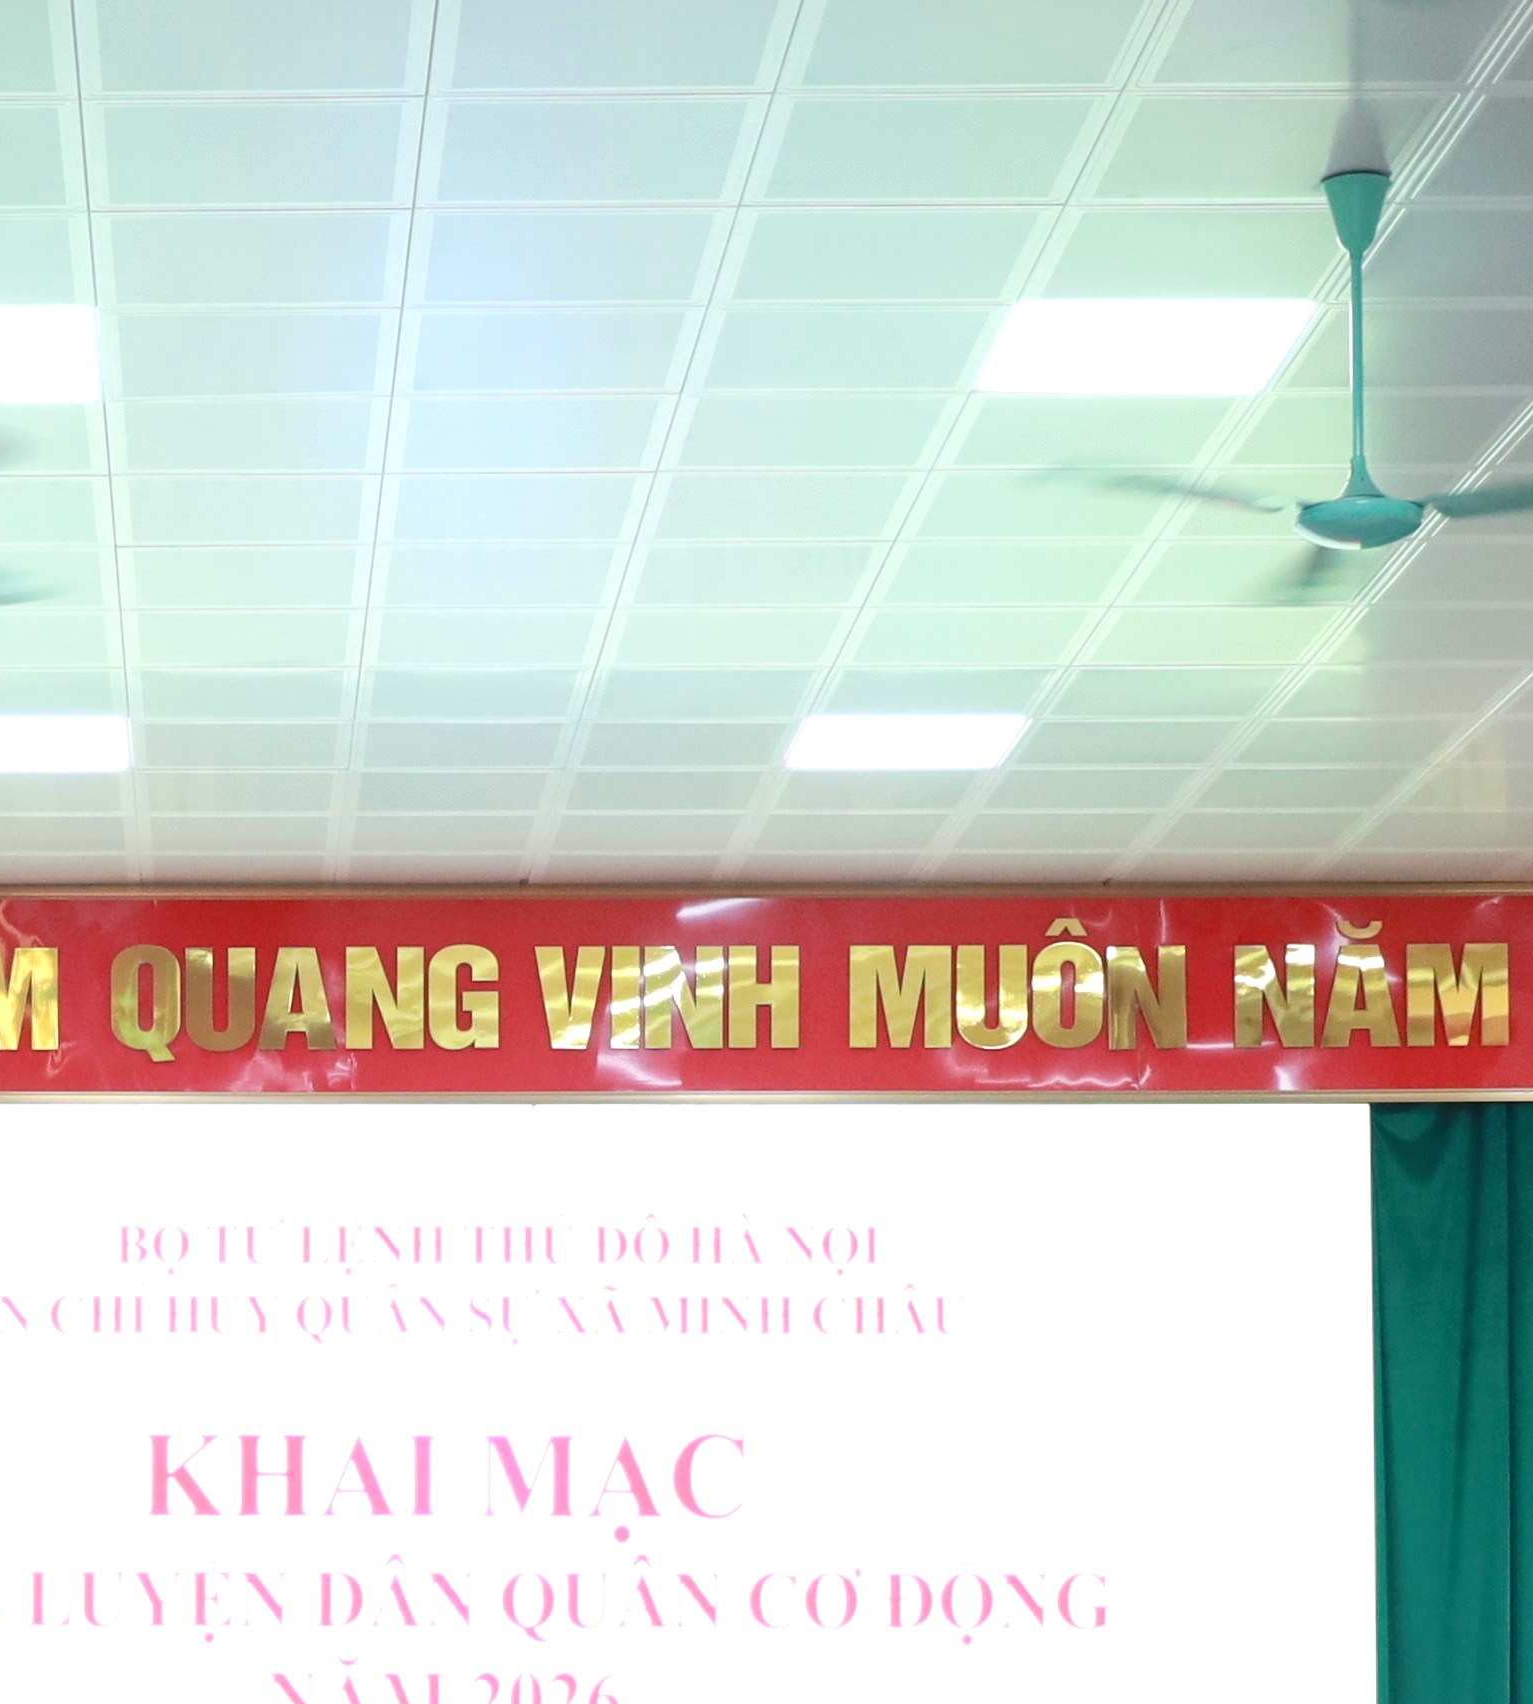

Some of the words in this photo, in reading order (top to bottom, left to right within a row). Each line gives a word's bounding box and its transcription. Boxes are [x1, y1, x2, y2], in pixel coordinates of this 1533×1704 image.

[109, 943, 500, 1063] QUANG
[535, 945, 802, 1050] VINH
[848, 917, 1189, 1052] MUÔN
[1233, 922, 1512, 1049] NĂM
[149, 1435, 433, 1516] KHAI
[485, 1434, 744, 1543] MẠC
[320, 1554, 470, 1626] DÂN
[502, 1555, 717, 1642] QUÂN
[749, 1568, 861, 1628] CƠ
